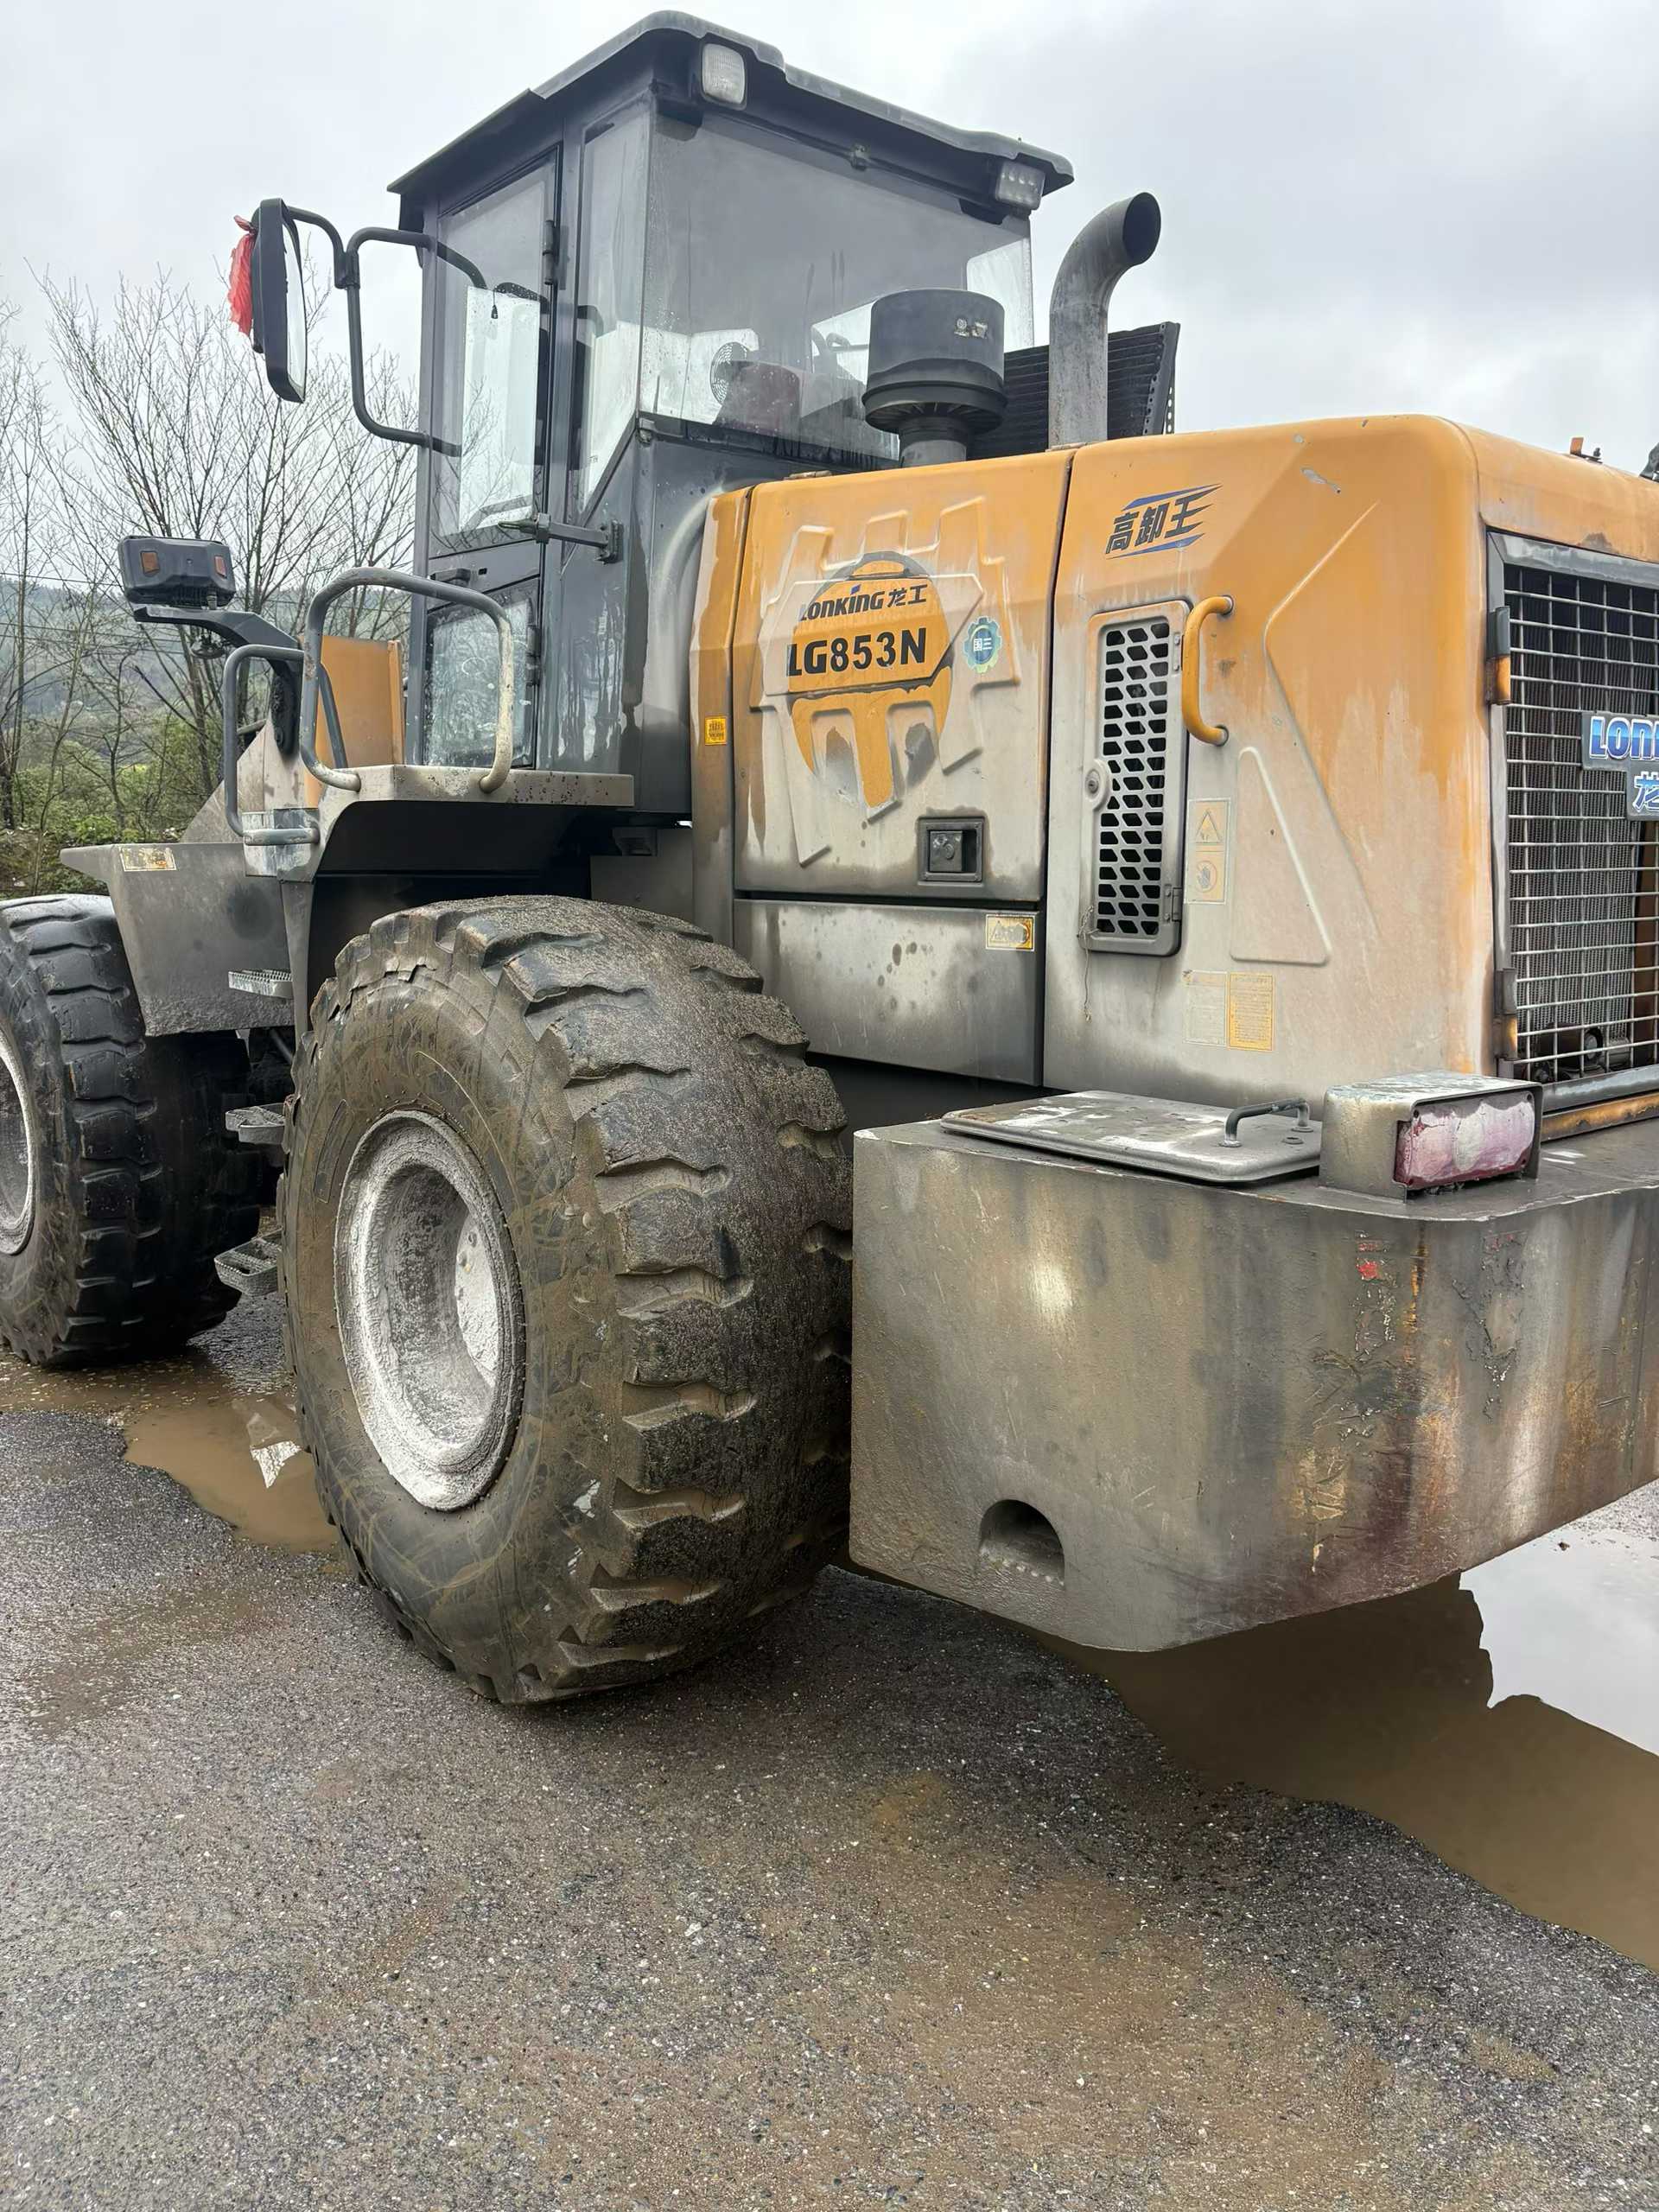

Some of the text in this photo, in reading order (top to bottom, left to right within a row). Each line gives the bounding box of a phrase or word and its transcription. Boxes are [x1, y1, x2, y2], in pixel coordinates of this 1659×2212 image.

[887, 584, 928, 607] 龙工
[787, 626, 927, 677] LG853N
[1589, 715, 1659, 761] LON
